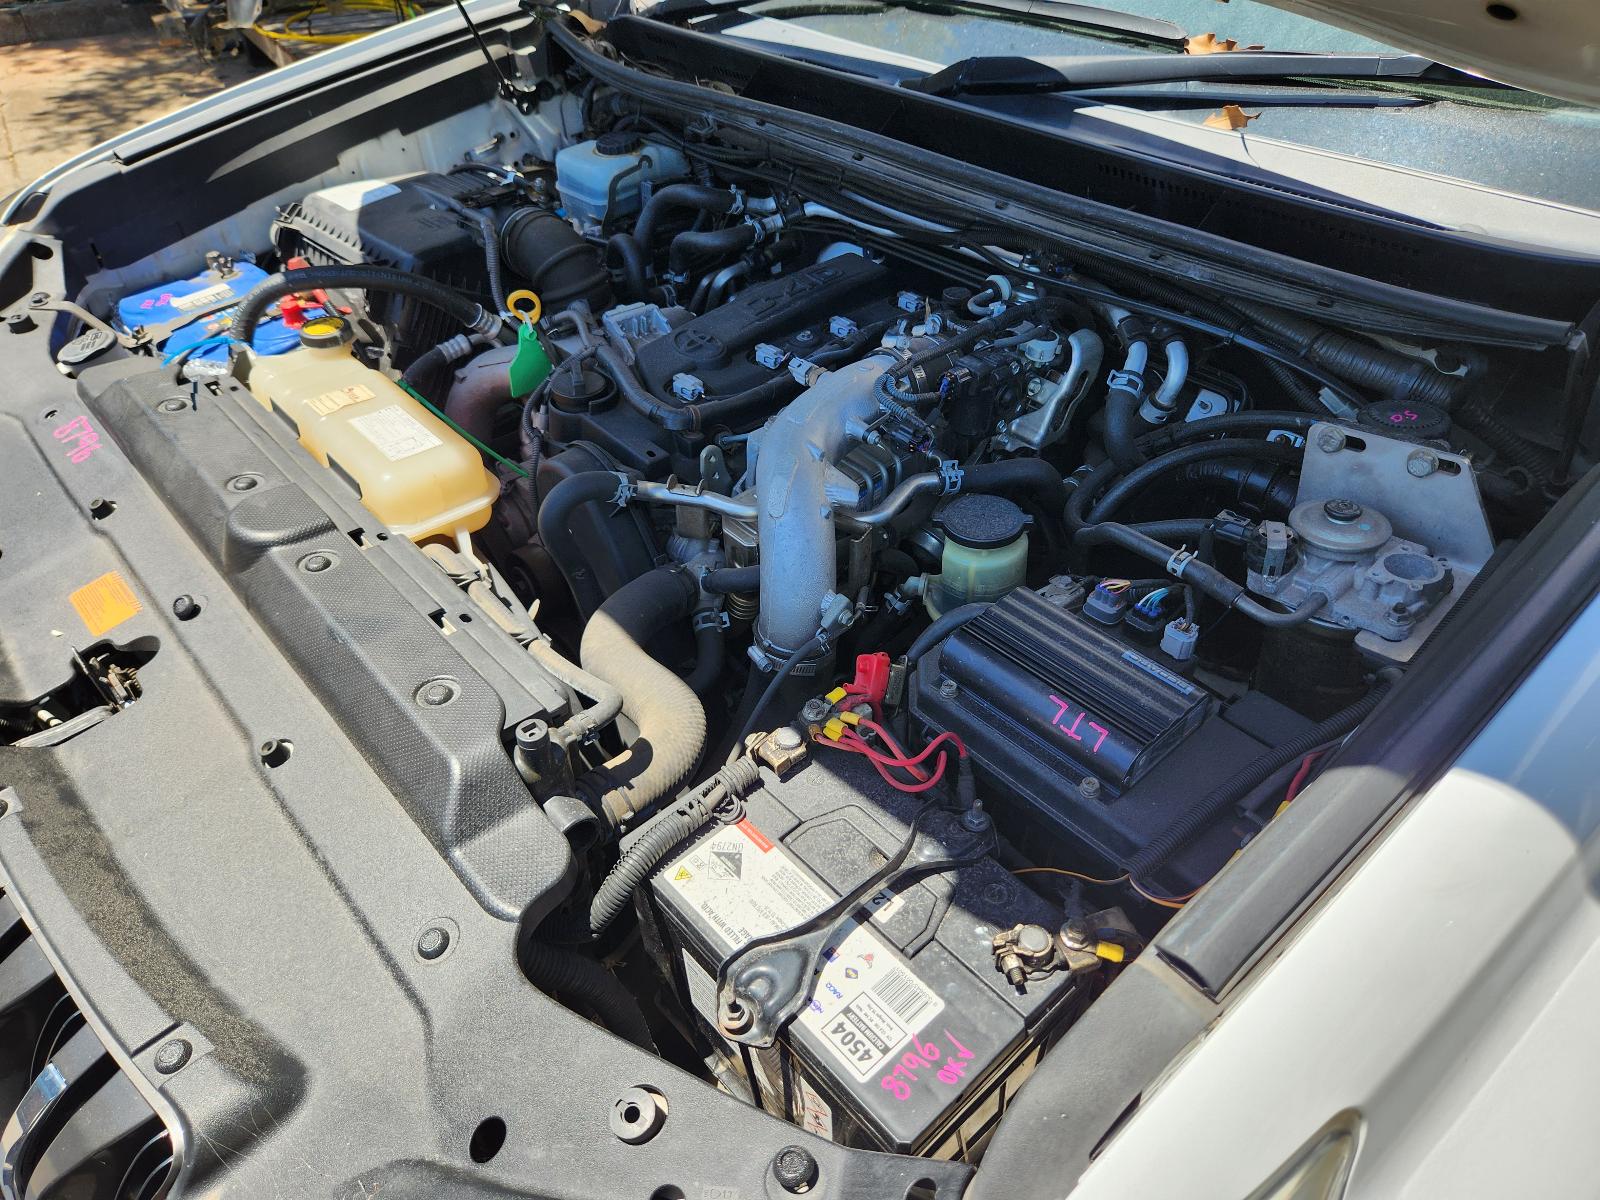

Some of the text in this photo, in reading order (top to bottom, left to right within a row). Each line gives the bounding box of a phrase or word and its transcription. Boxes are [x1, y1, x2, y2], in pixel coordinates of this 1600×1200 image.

[1049, 694, 1110, 754] LTL
[722, 925, 743, 946] FILLED
[844, 1009, 868, 1033] BATTERY
[829, 1019, 876, 1066] 4504
[861, 1027, 886, 1051] CALCIUM
